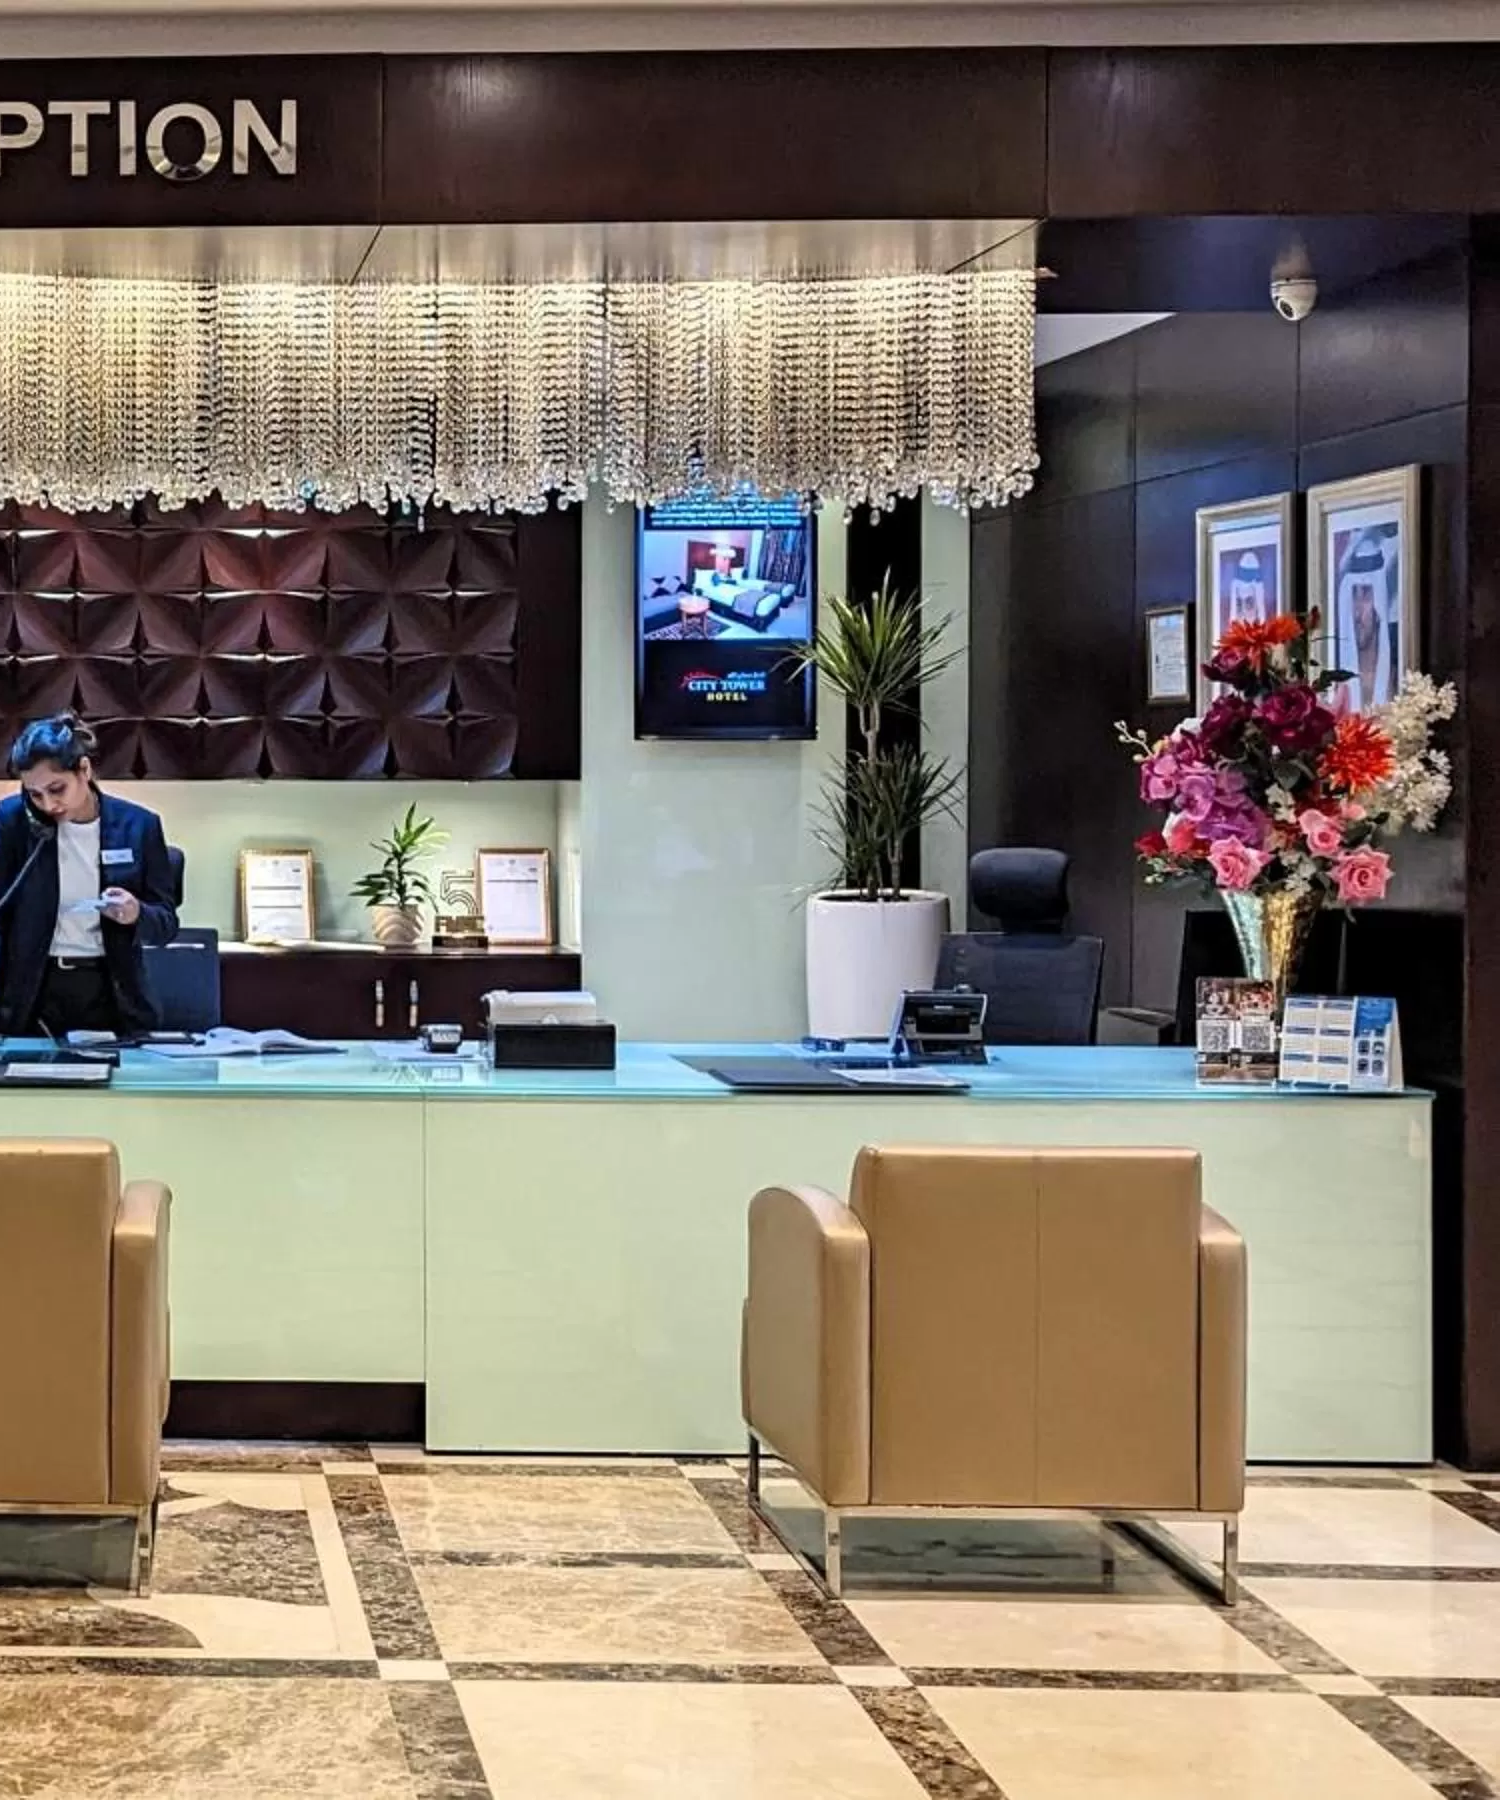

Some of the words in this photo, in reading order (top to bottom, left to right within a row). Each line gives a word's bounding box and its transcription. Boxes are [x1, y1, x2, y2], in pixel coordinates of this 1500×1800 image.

[688, 680, 717, 692] CITY
[720, 680, 766, 692] TOWER
[706, 692, 748, 702] HOTEL
